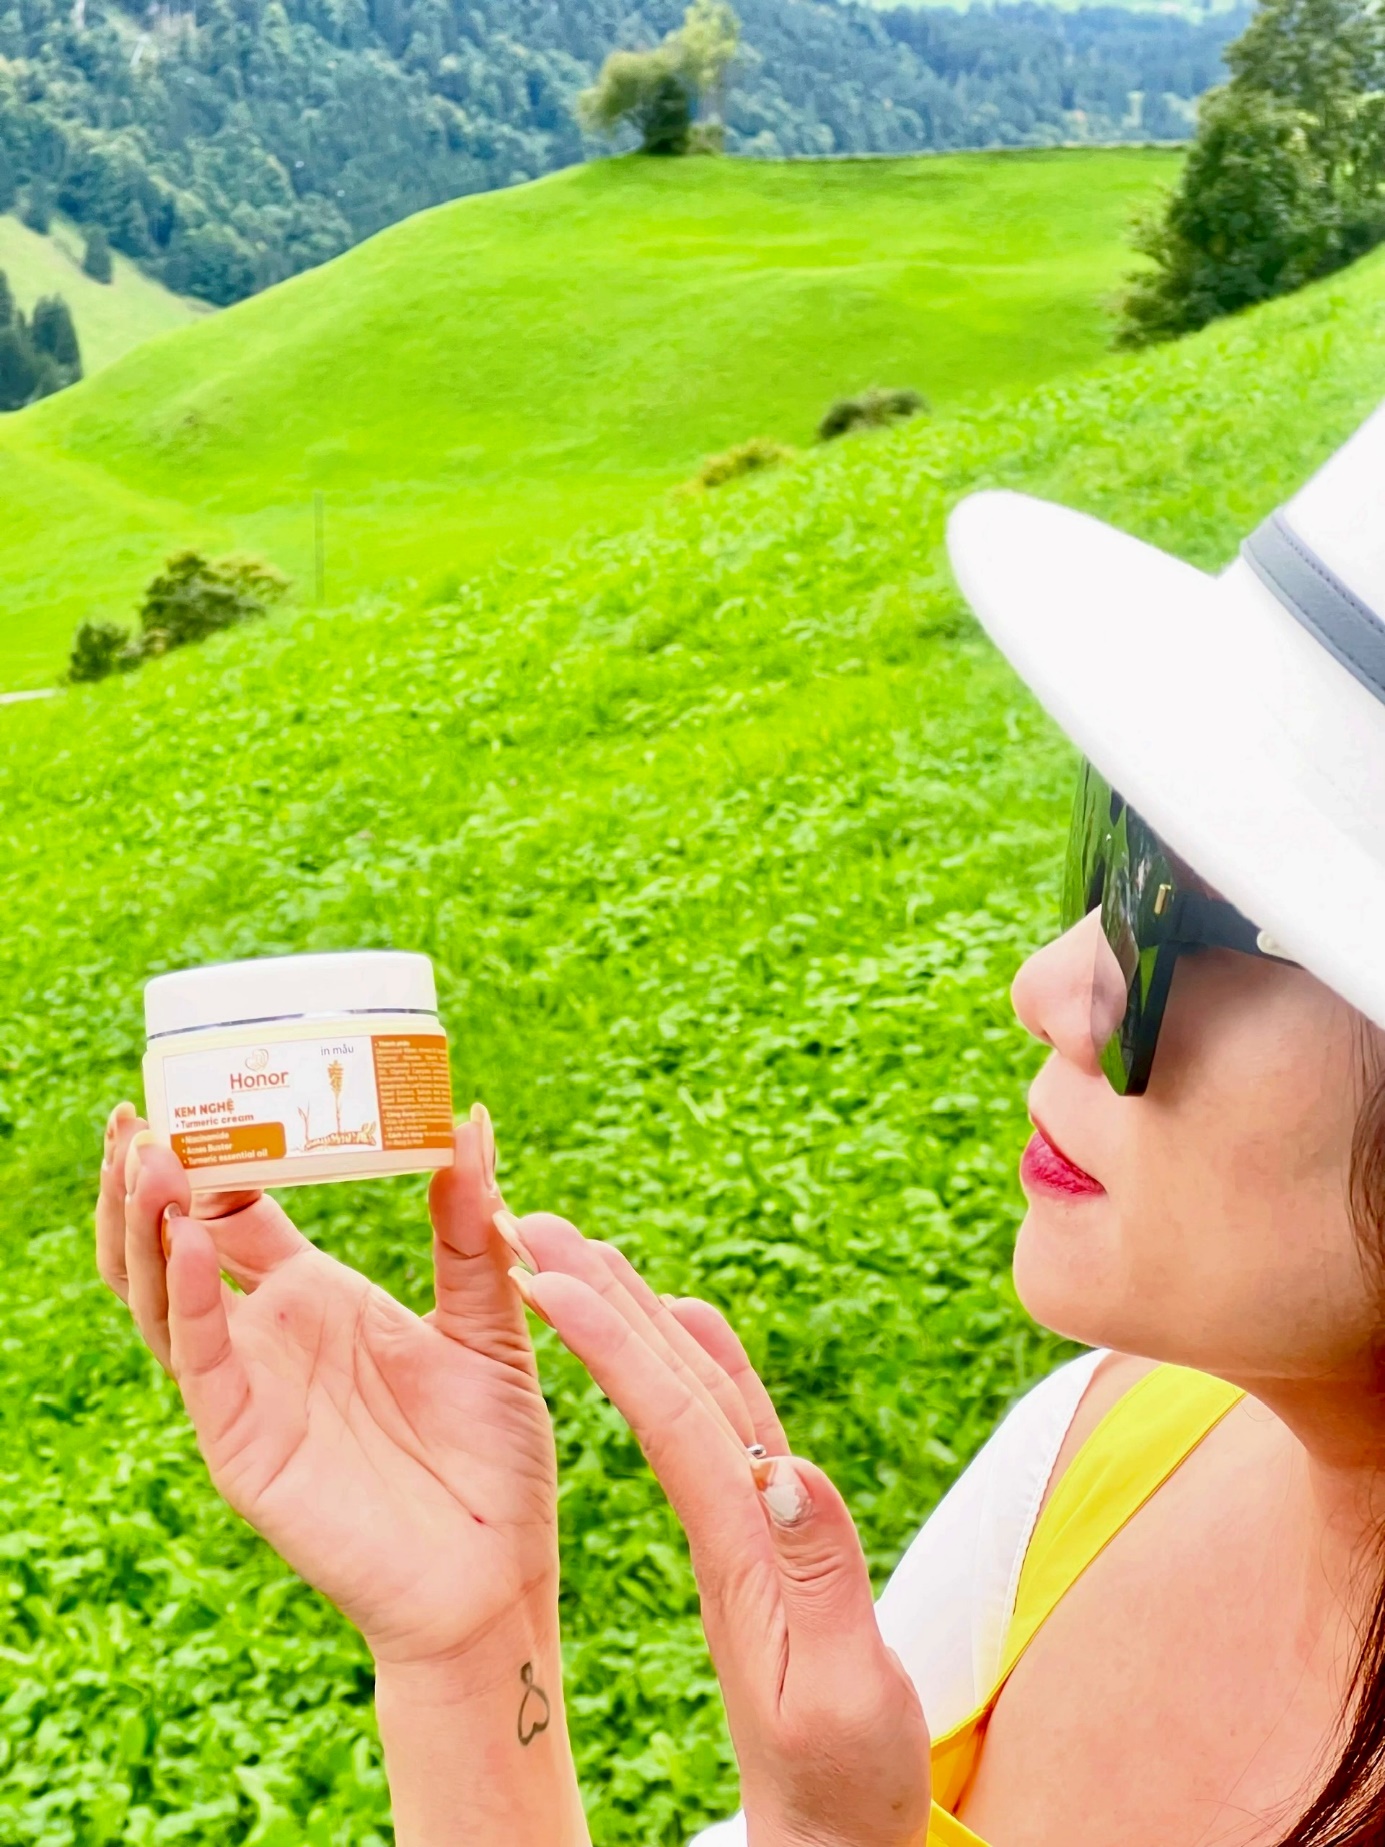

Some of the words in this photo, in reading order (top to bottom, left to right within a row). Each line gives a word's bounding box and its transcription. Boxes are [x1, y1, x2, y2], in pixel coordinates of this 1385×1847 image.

[320, 1046, 330, 1056] in
[230, 1072, 289, 1089] Honor
[174, 1106, 196, 1118] KEM
[199, 1098, 235, 1115] NGHỆ
[181, 1117, 219, 1129] Turmeric
[221, 1114, 254, 1123] cream
[219, 1150, 255, 1161] essential
[257, 1149, 268, 1158] oil
